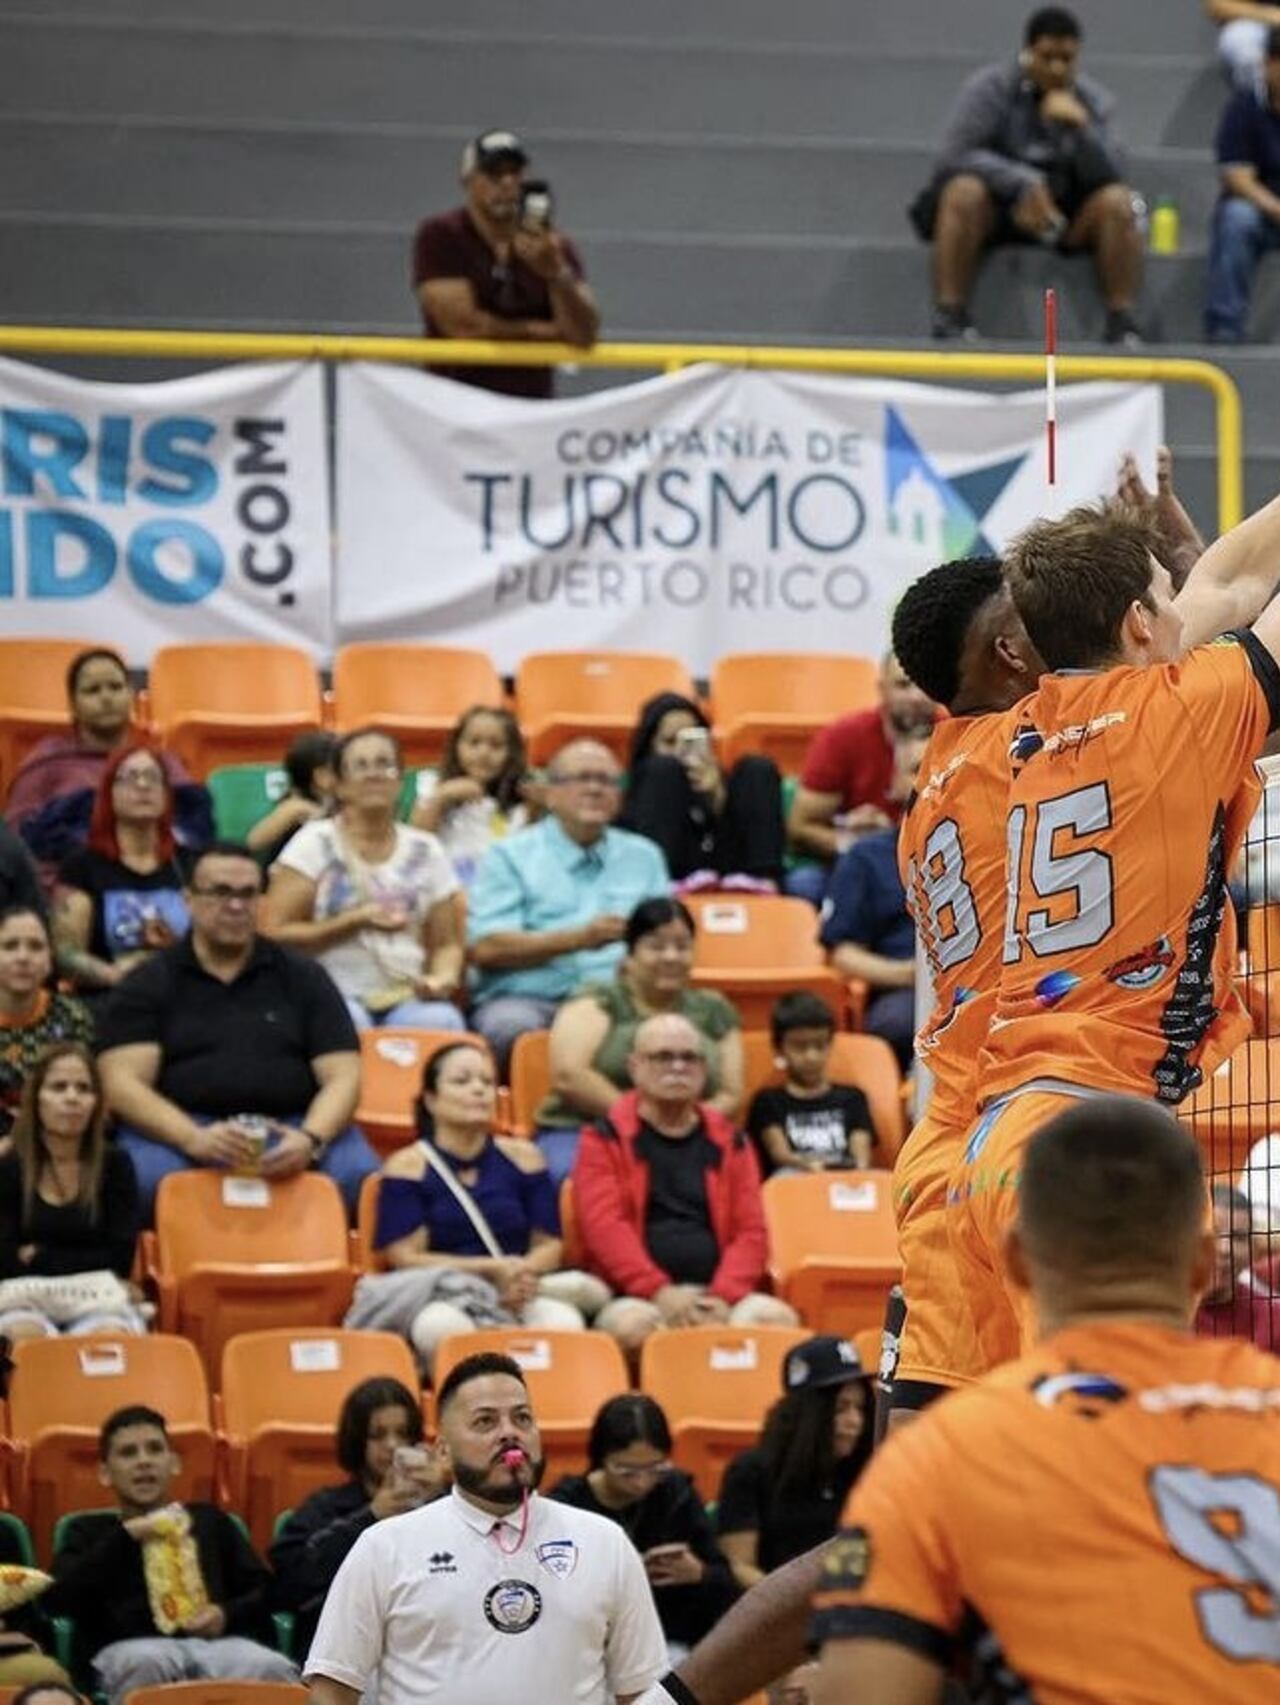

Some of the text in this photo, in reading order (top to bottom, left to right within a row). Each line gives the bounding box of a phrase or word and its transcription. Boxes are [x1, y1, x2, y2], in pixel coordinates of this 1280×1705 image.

[806, 431, 864, 466] DE
[234, 418, 295, 608] .COM
[463, 469, 866, 553] TURISMO
[495, 560, 870, 612] PUERTO RICO
[1002, 781, 1115, 965] 15
